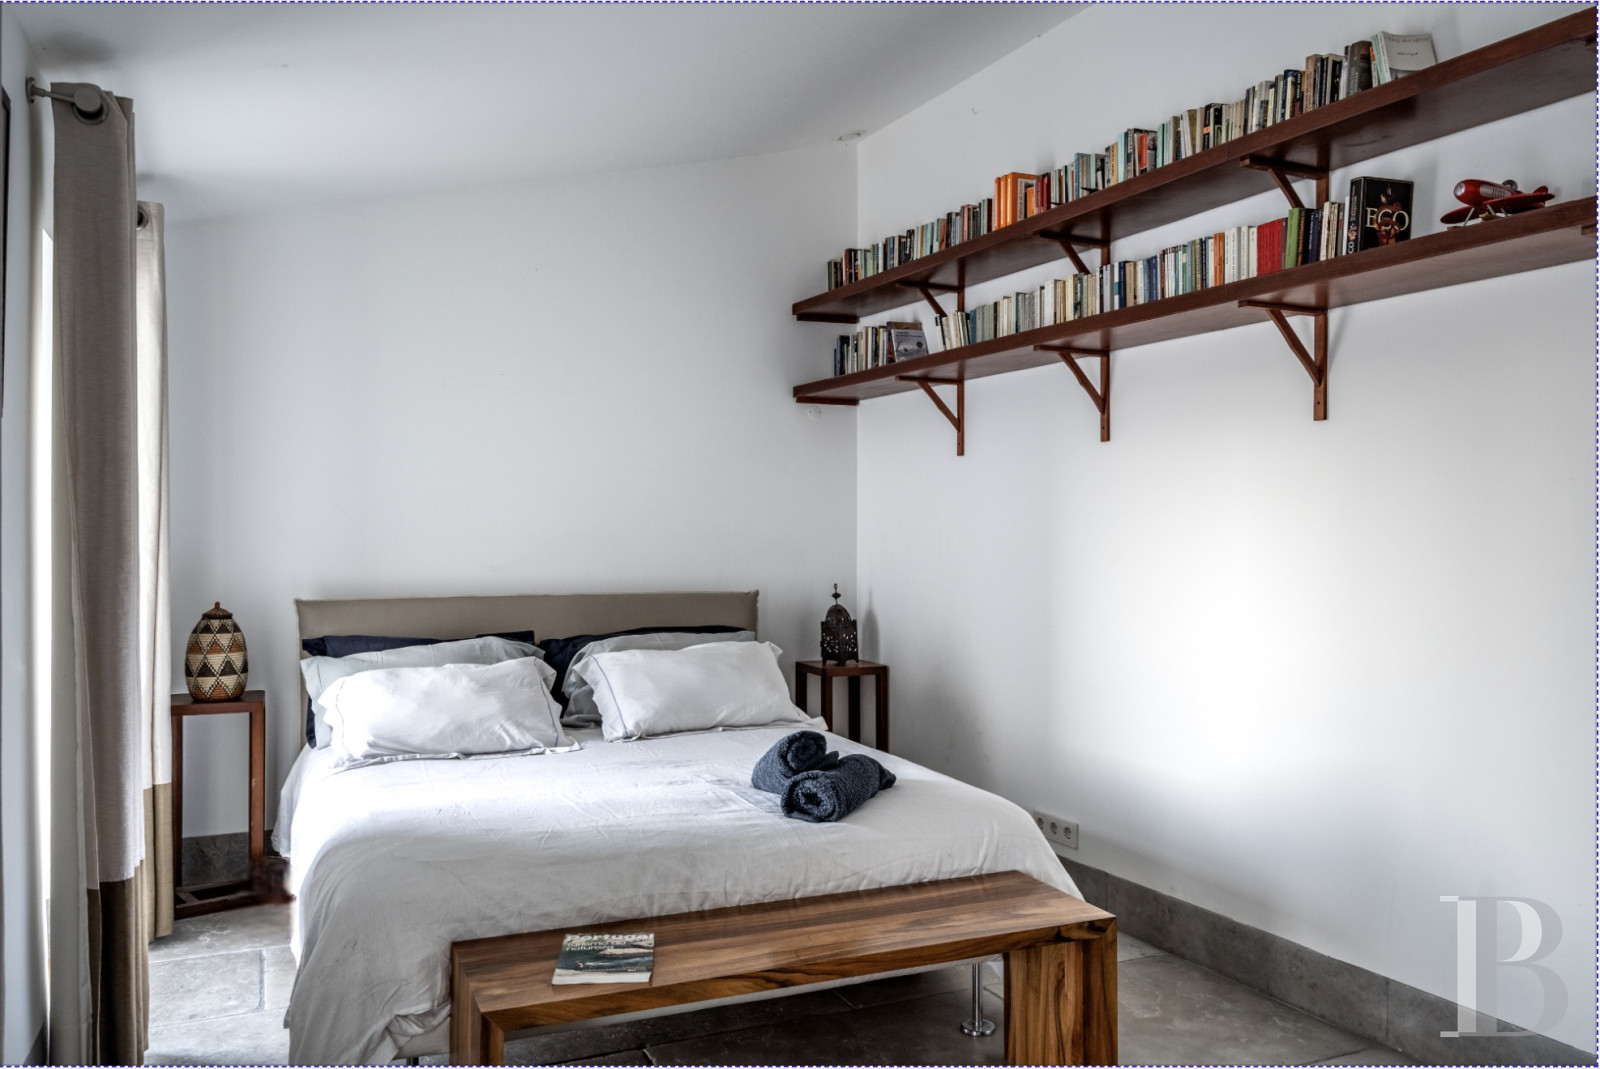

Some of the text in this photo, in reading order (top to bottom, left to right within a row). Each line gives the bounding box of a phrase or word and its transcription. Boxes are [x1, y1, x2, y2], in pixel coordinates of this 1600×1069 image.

[1365, 207, 1410, 231] ECO
[1347, 241, 1355, 254] CO
[565, 933, 655, 942] Portugal
